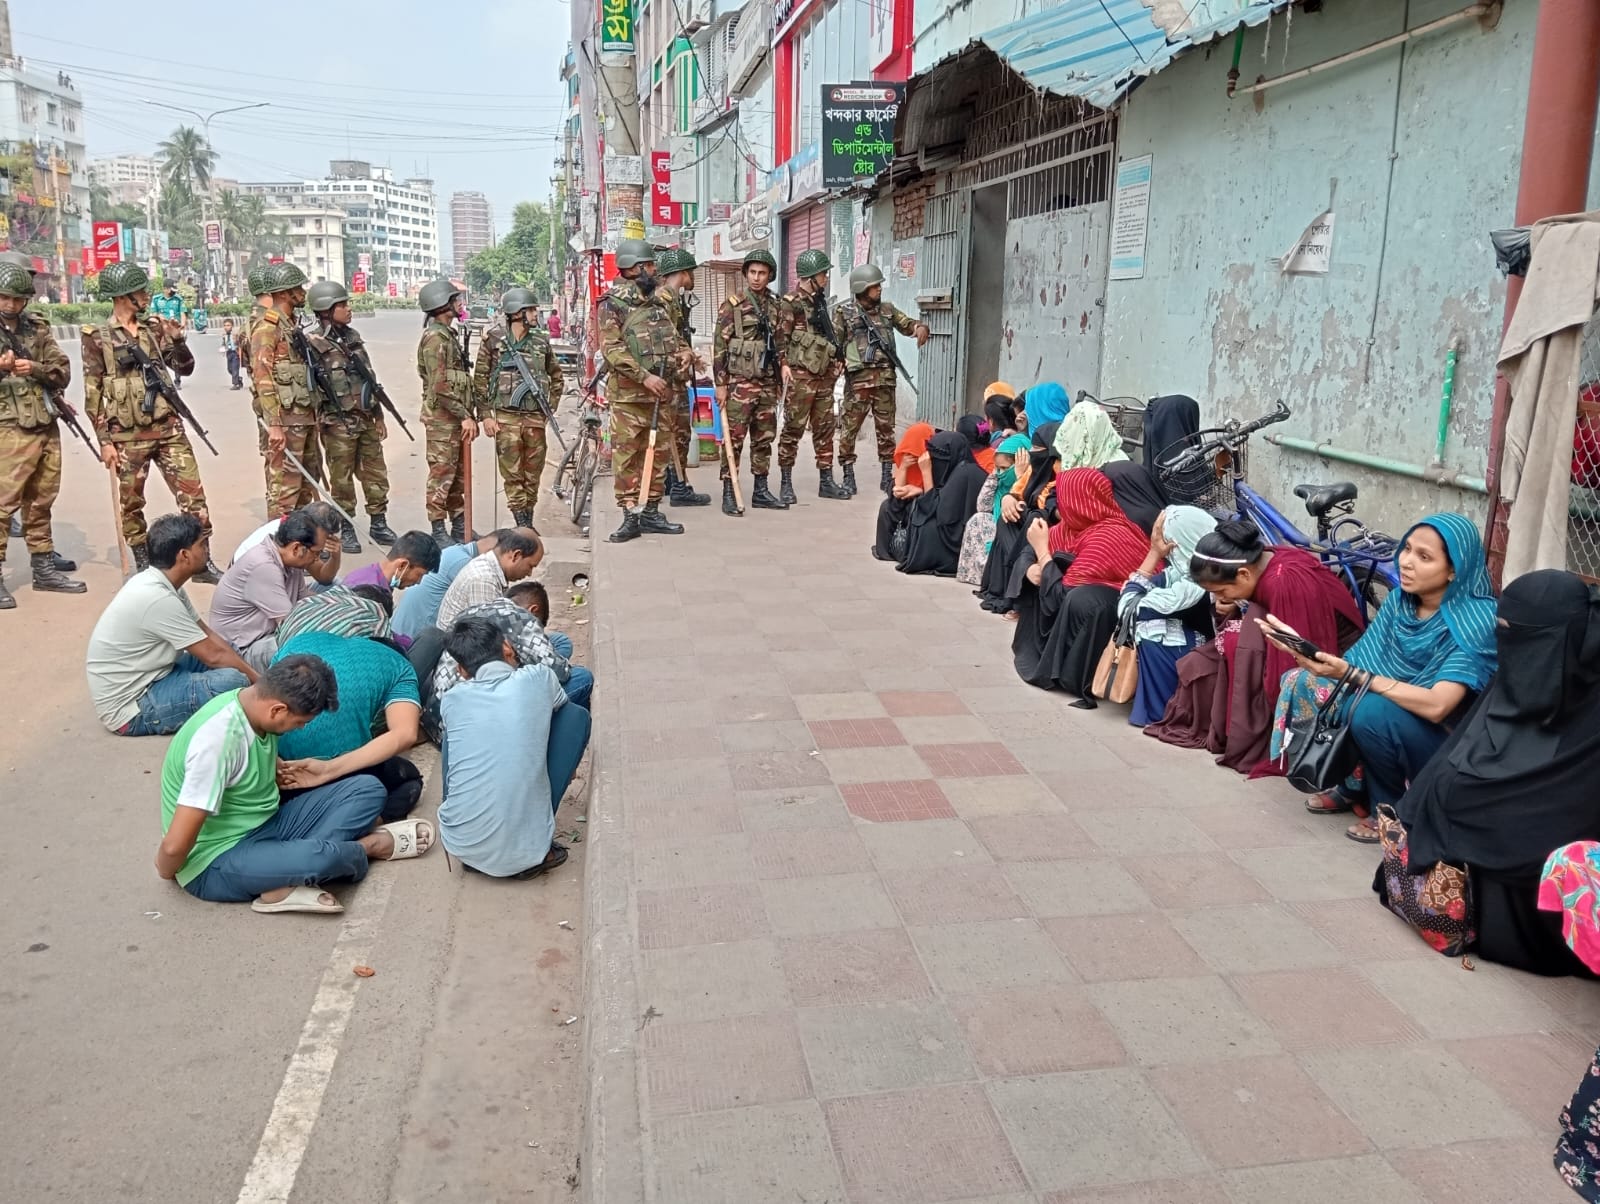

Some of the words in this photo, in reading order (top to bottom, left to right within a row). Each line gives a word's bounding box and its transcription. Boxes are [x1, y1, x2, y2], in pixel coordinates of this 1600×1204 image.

[825, 108, 862, 122] খন্দকার
[855, 124, 872, 136] এন্ড
[97, 227, 115, 235] AKS
